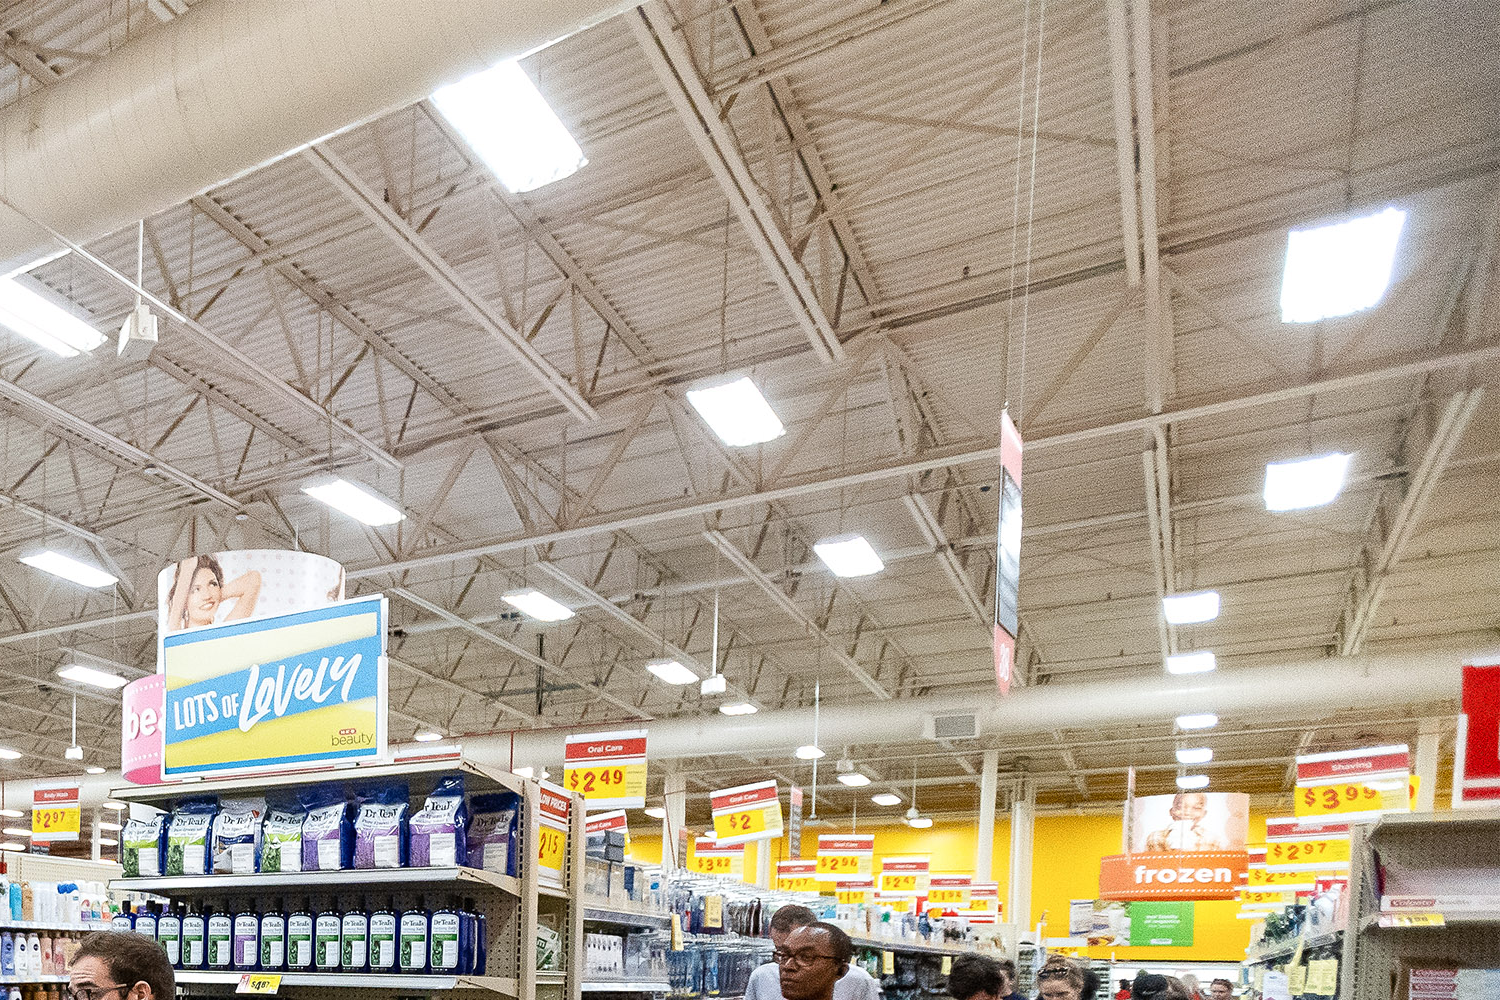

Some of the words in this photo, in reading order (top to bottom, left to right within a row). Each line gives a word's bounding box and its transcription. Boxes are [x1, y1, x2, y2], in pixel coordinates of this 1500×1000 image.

[174, 691, 219, 731] LOTS
[221, 692, 240, 718] OF
[331, 733, 374, 746] beauty
[1332, 762, 1372, 771] Shaving
[730, 814, 750, 830] $2
[1135, 866, 1231, 884] frozen
